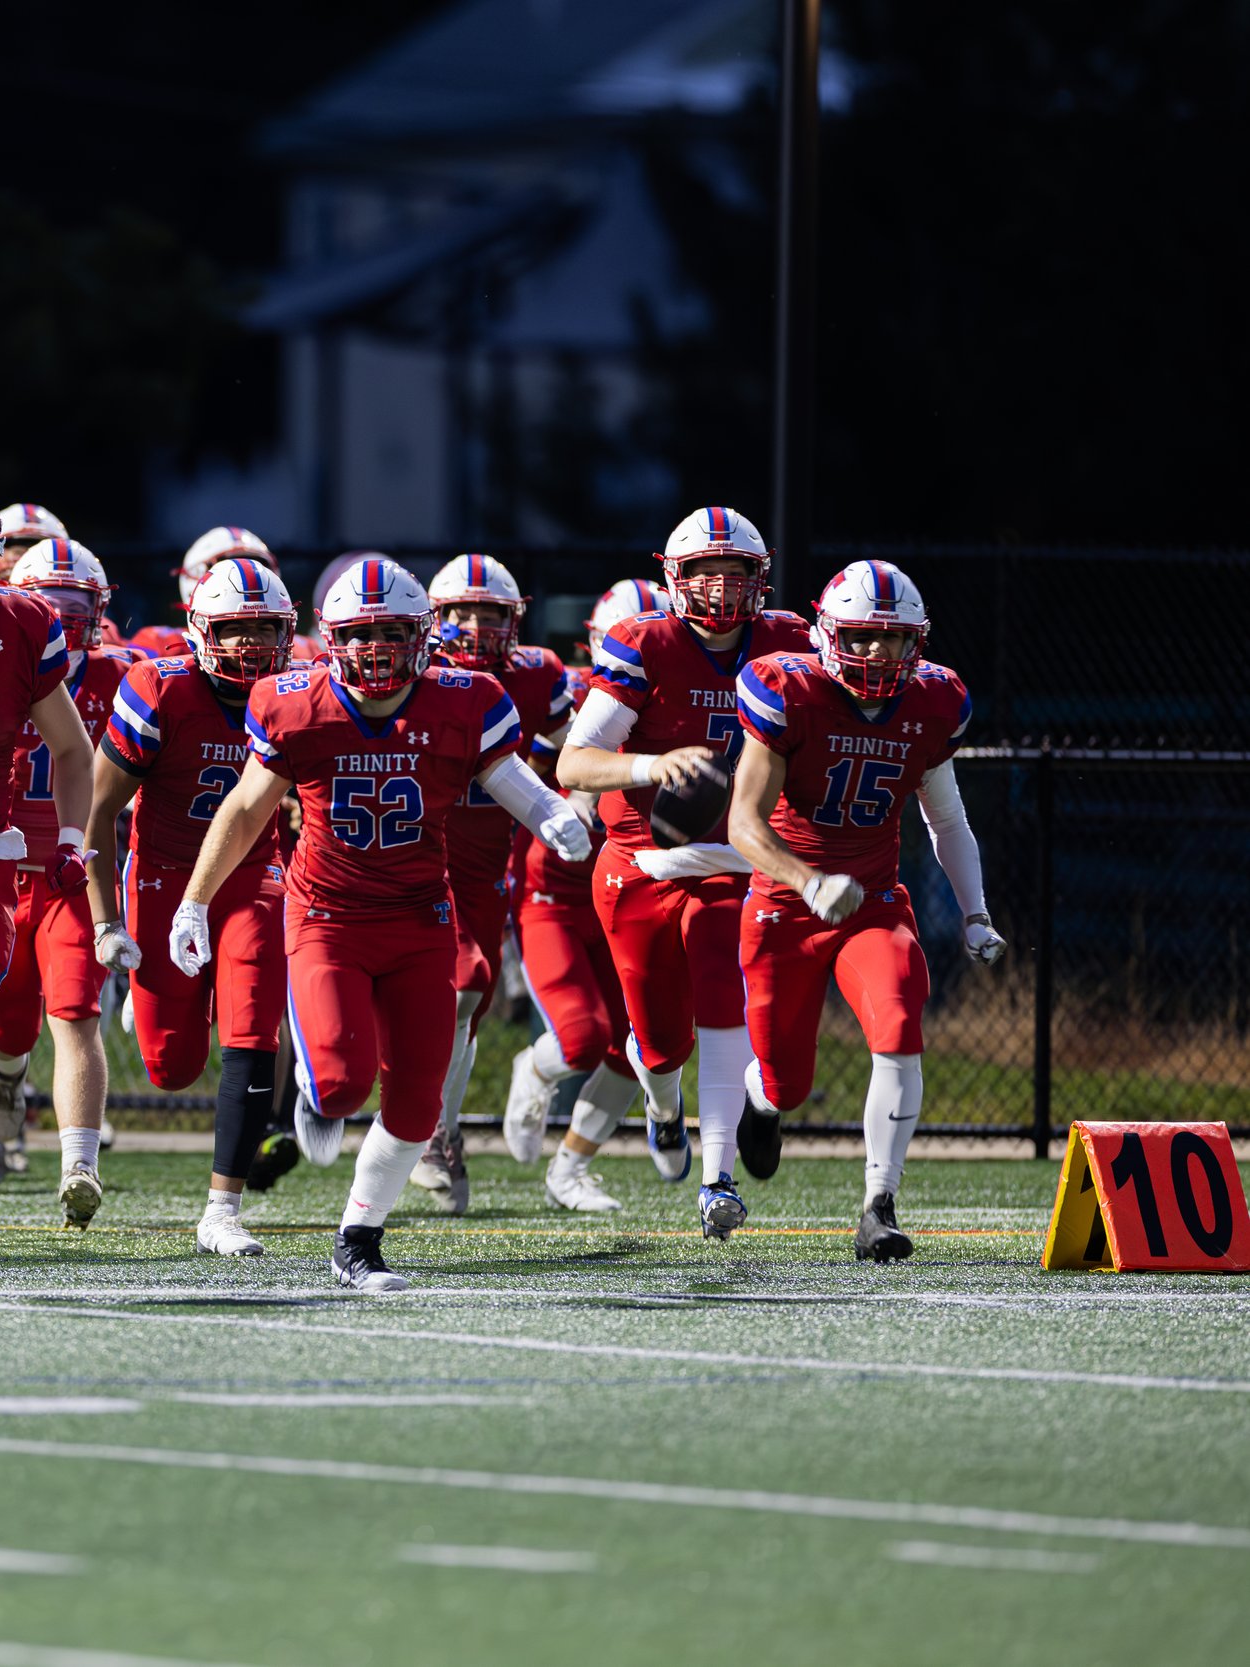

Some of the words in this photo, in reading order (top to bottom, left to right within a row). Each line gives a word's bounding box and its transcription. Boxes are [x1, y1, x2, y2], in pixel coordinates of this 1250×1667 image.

[359, 604, 389, 613] Riddell
[871, 611, 899, 621] Riddell
[152, 657, 190, 680] 21
[276, 671, 311, 696] 52
[690, 689, 737, 709] TRIN
[200, 742, 248, 762] TRIN
[706, 712, 747, 777] 7
[827, 734, 912, 761] TRINITY
[23, 740, 54, 801] 1
[334, 753, 420, 773] TRINITY
[187, 764, 242, 821] 2
[812, 757, 906, 828] 15
[330, 775, 425, 851] 52
[1110, 1131, 1233, 1259] 10
